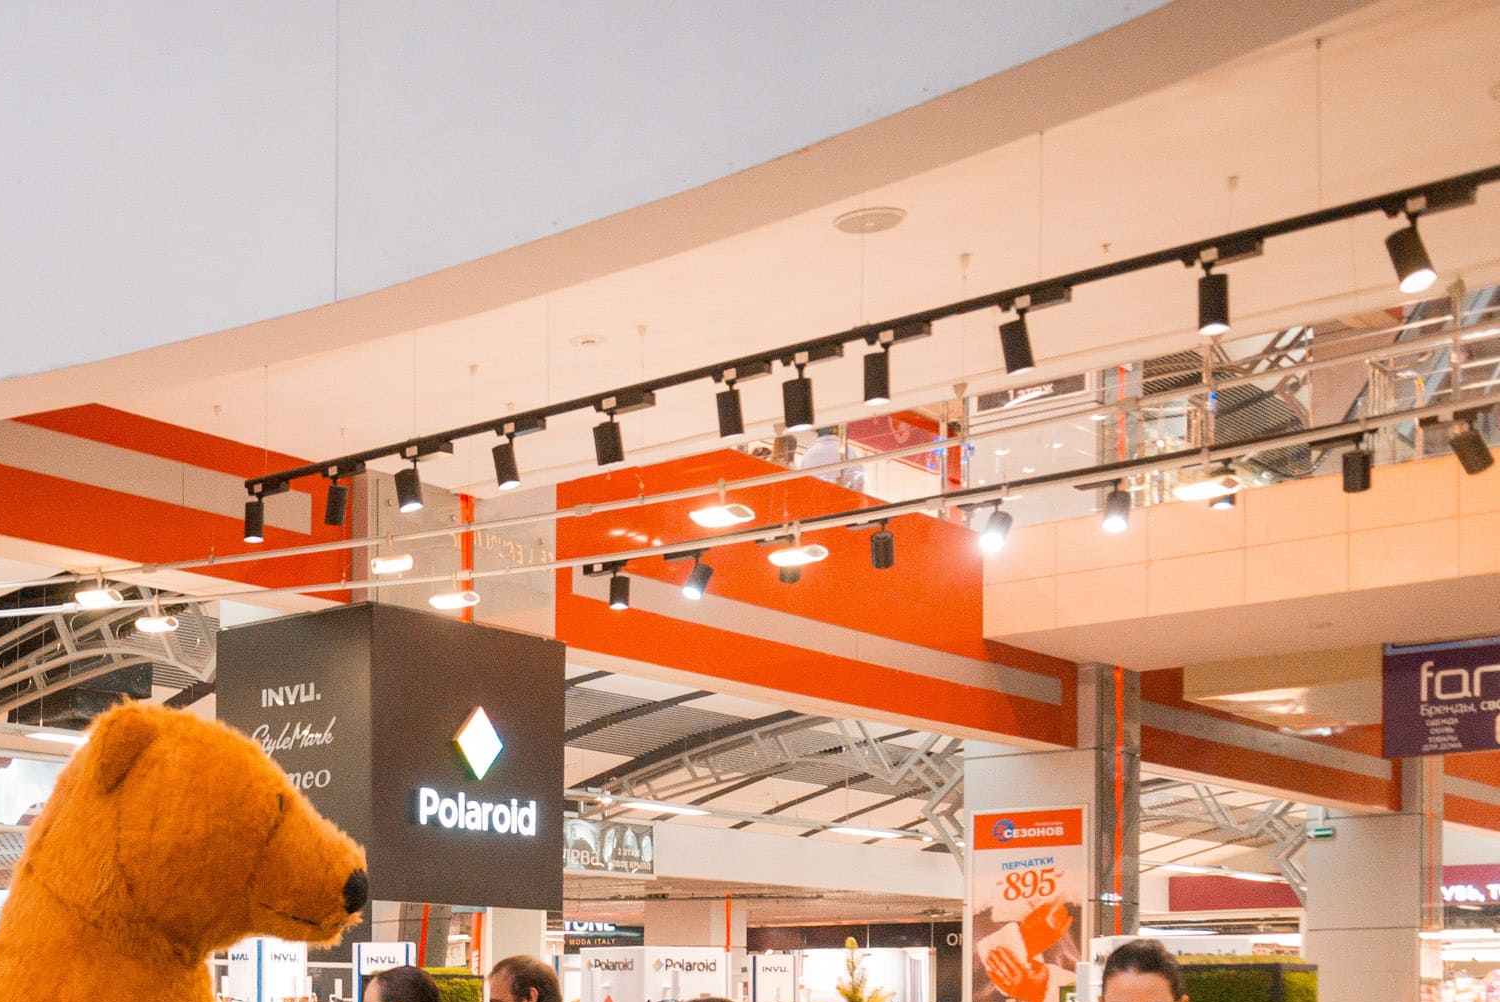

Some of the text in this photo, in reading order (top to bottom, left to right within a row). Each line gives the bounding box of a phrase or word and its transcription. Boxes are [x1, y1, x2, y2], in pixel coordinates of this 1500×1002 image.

[261, 682, 322, 708] INVU.
[251, 716, 336, 758] StyleMark
[419, 787, 537, 836] Polaroid
[1002, 857, 1054, 870] ПЕРЧАТКИ
[1003, 868, 1056, 901] 895
[569, 938, 592, 946] MODA
[594, 958, 635, 971] Polaroid
[665, 958, 717, 973] Polaroid
